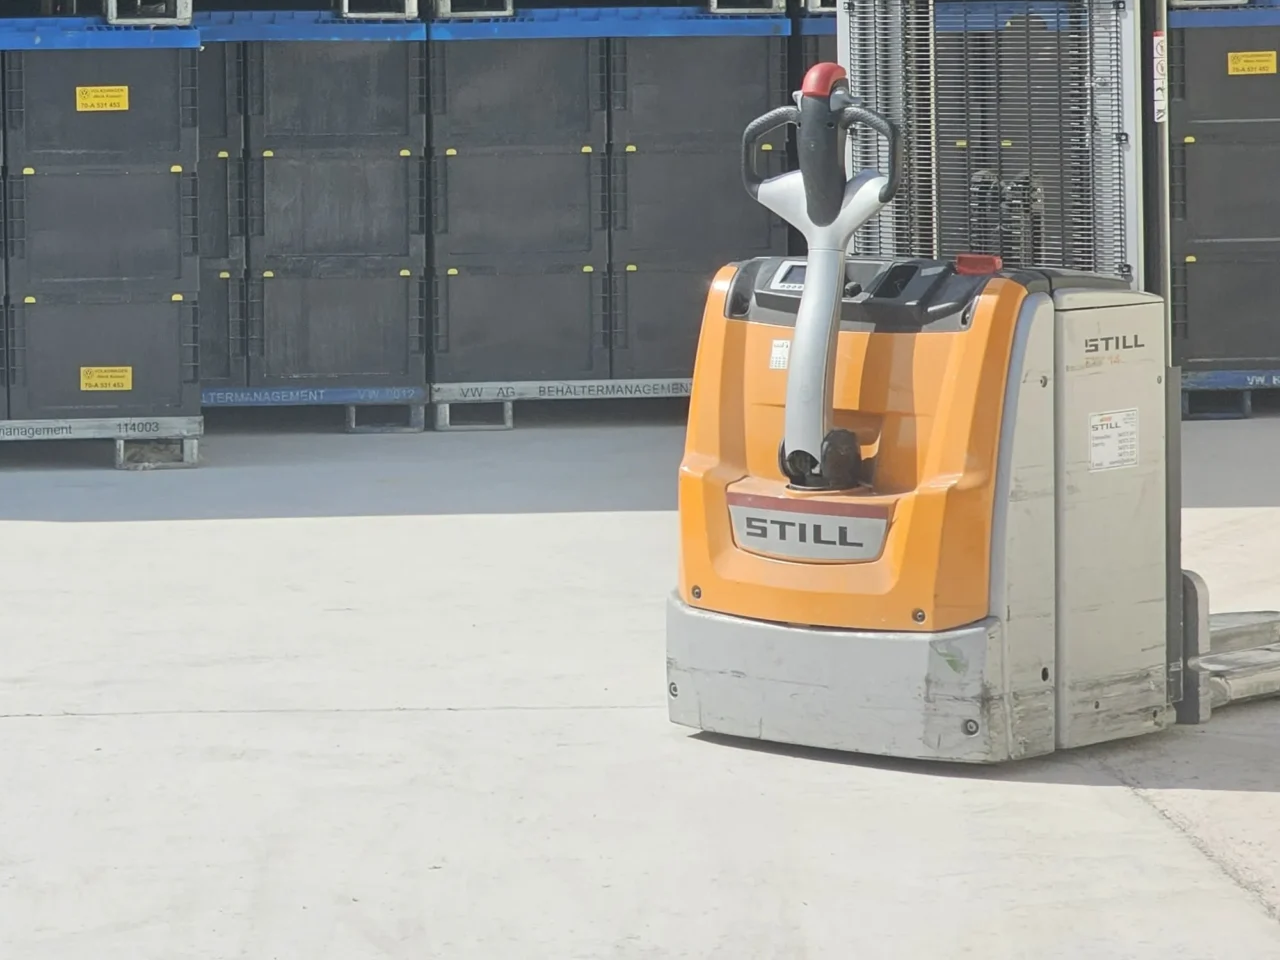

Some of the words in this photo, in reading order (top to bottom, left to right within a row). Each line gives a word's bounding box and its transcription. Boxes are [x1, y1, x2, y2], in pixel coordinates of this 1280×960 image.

[1085, 334, 1145, 353] STILL
[460, 387, 483, 398] VW
[496, 386, 515, 397] AG
[116, 422, 159, 434] 114003
[1091, 422, 1122, 431] STILL
[746, 516, 864, 548] STILL
